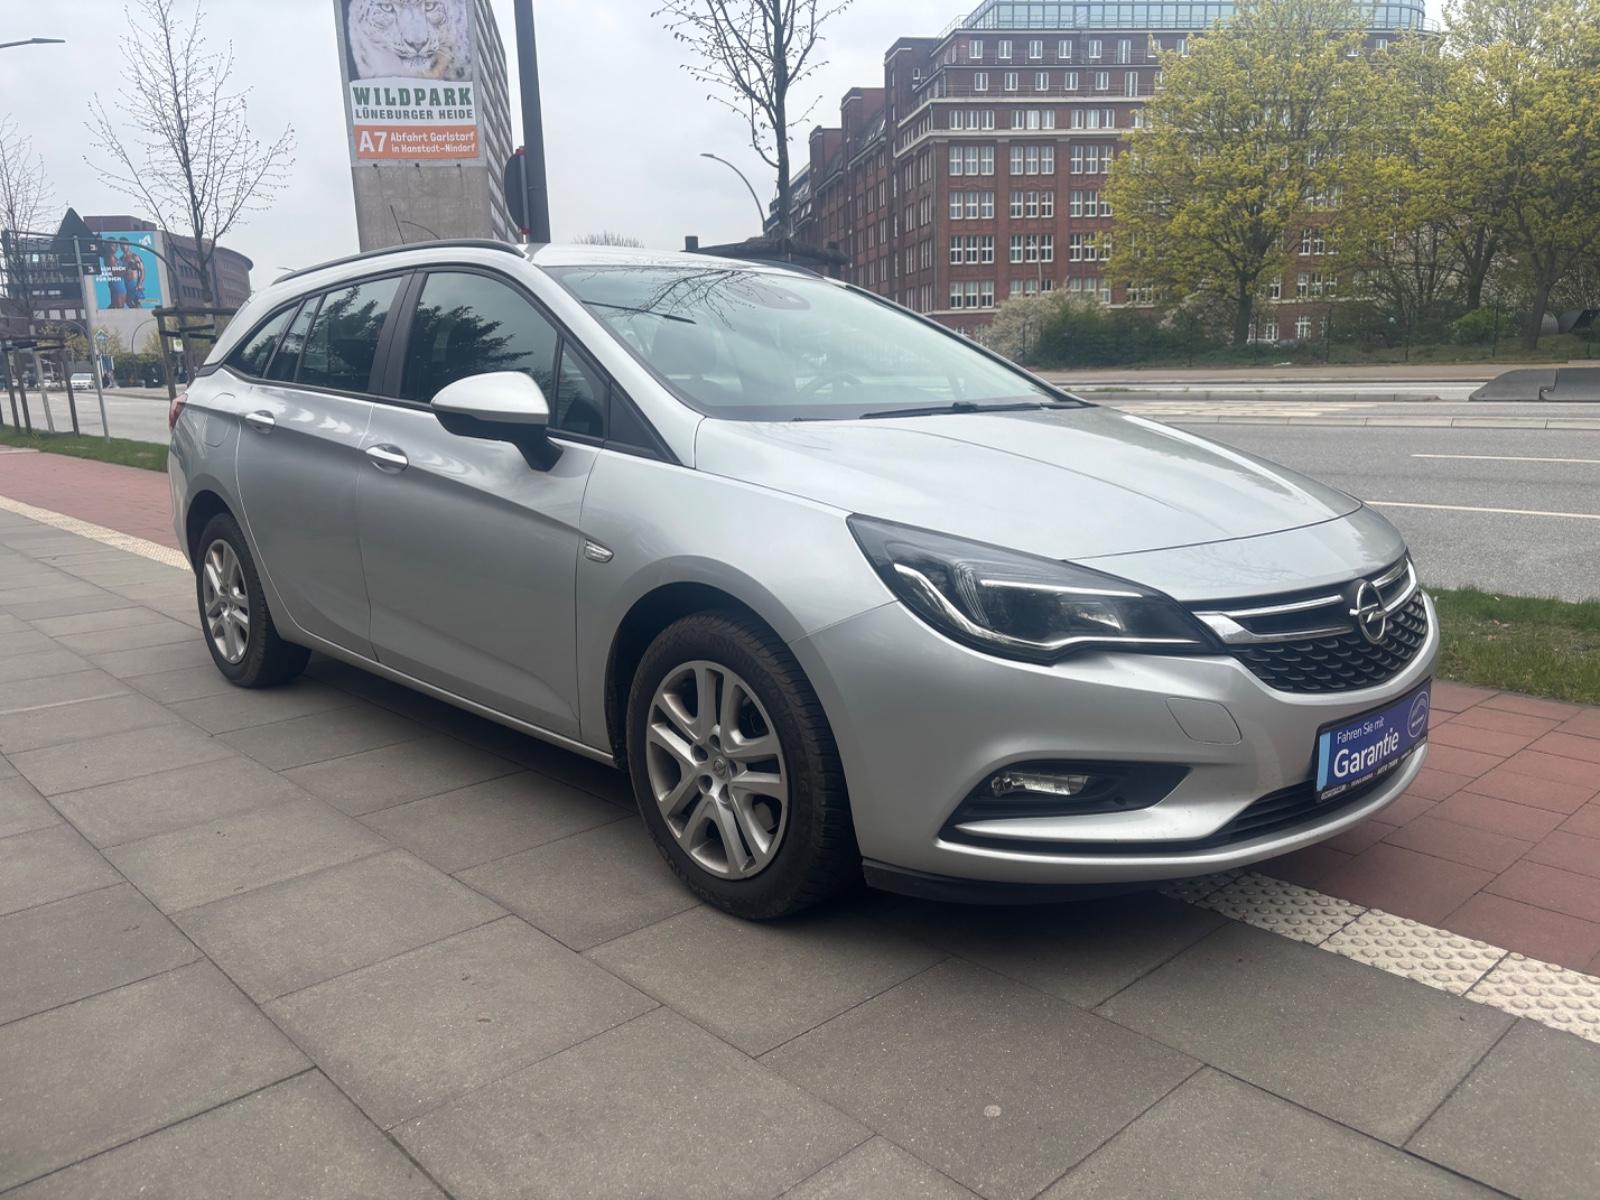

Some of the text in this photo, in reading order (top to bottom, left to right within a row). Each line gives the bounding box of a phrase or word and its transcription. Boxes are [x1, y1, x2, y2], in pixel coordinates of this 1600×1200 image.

[352, 87, 472, 106] WILDPARK
[355, 107, 474, 120] LÜNEBURGER HEIDE
[359, 130, 388, 153] A7
[390, 131, 475, 143] Abfahrt Garlstorf
[391, 144, 400, 153] in
[1337, 715, 1385, 745] Fahren Sie mit
[1333, 727, 1400, 778] Garantie
